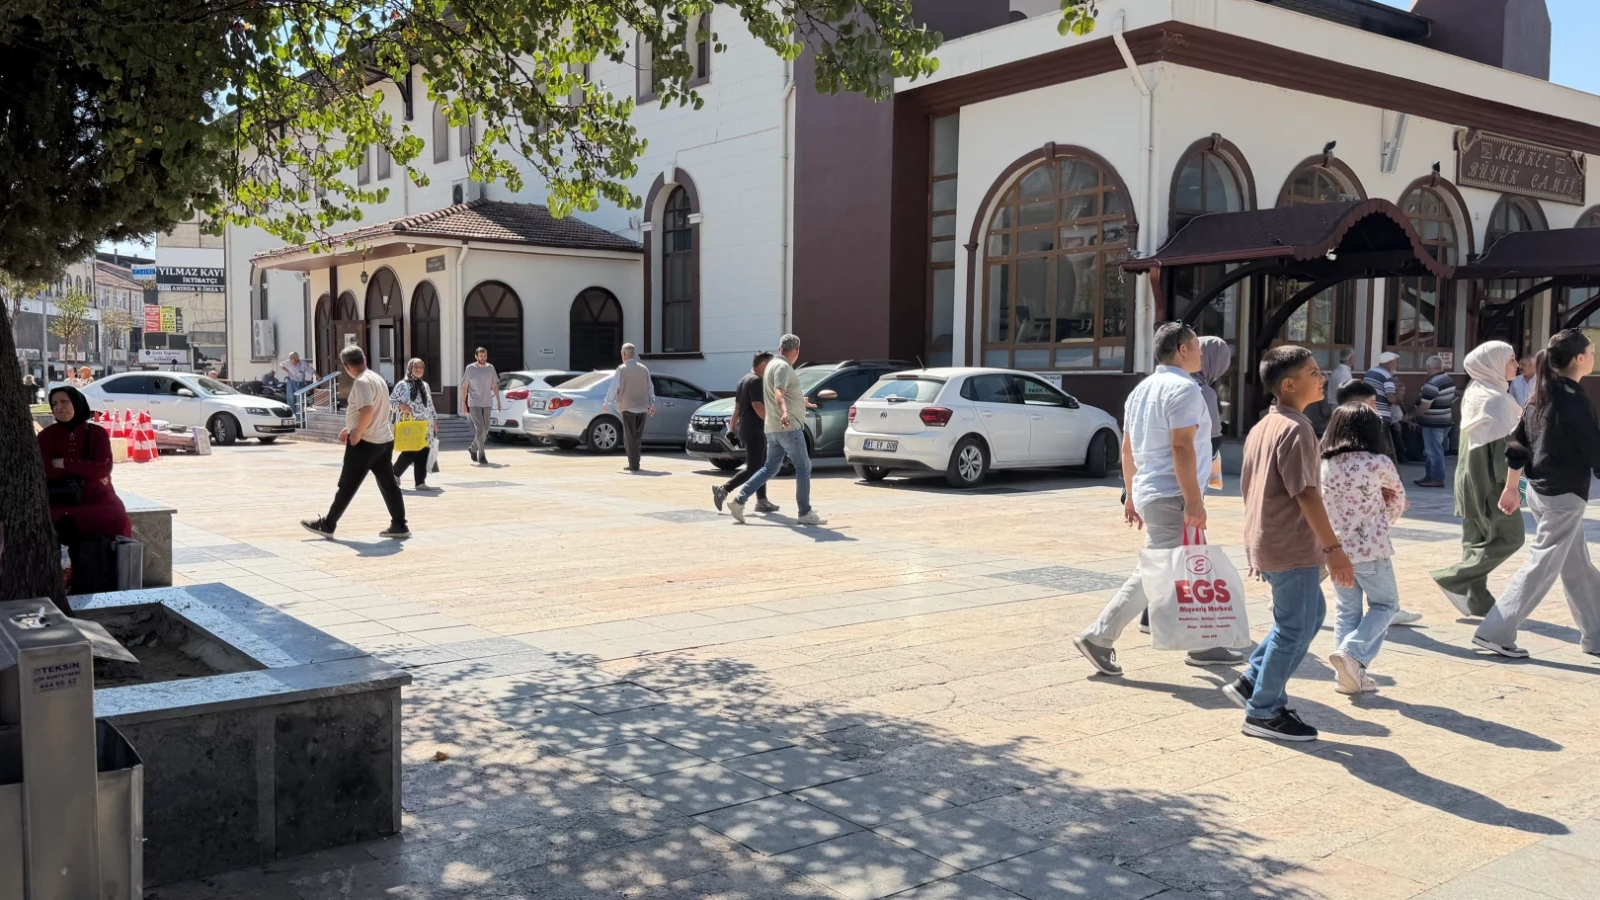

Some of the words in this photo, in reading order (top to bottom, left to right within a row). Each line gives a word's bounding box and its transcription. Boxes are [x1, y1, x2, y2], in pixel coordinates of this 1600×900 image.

[1495, 145, 1549, 169] MERKEZ
[1467, 161, 1520, 185] BÜYÜK
[159, 267, 198, 276] YILMAZ
[200, 269, 224, 277] KAYI
[1174, 578, 1231, 604] EGS
[1208, 604, 1234, 612] Merkezi
